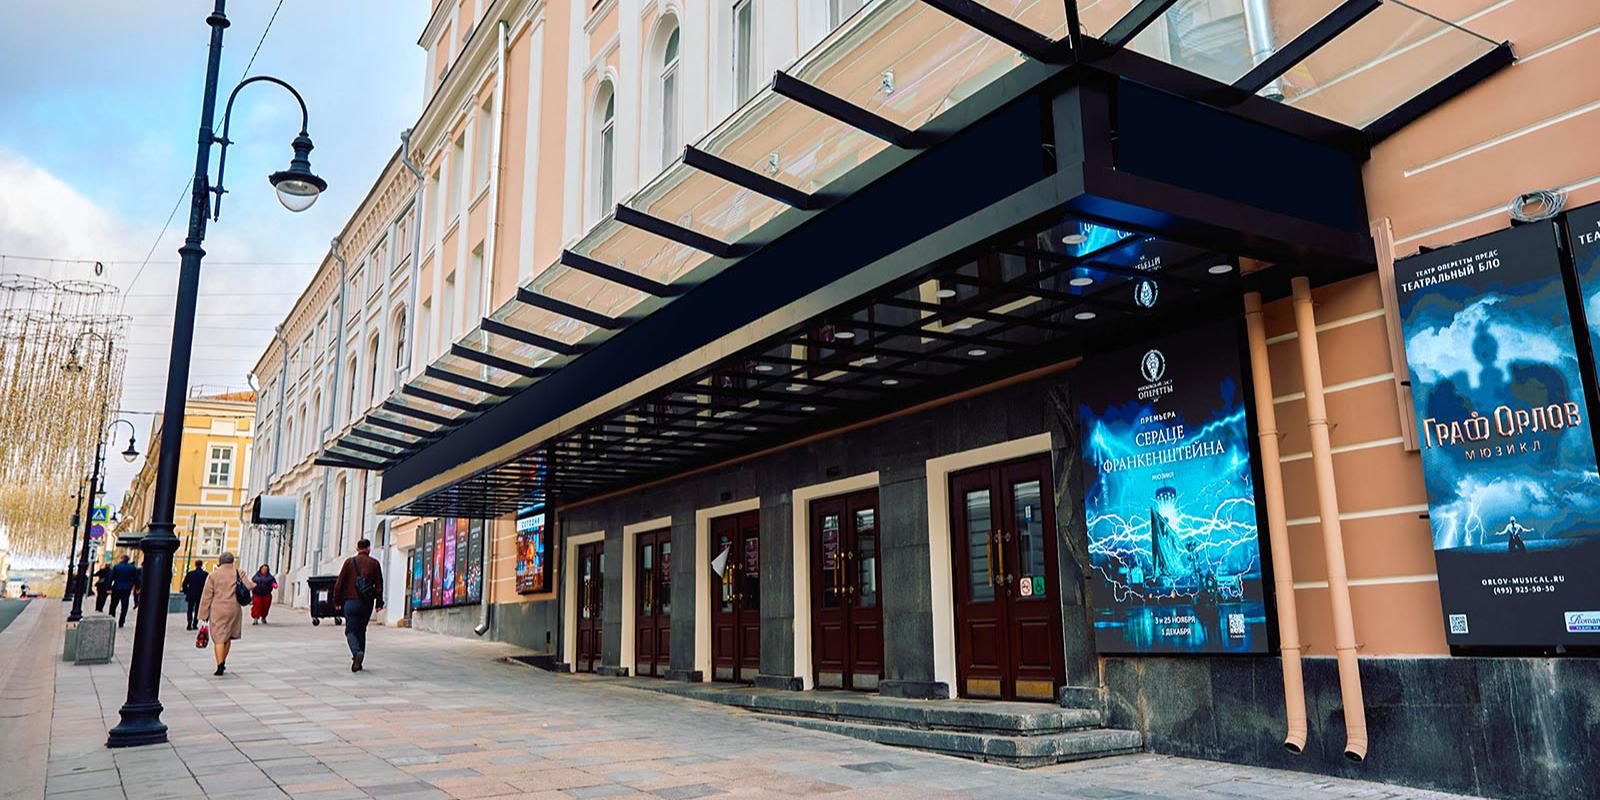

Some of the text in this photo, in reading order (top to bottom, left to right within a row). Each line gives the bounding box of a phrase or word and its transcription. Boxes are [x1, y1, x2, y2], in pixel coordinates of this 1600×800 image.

[1416, 249, 1498, 278] ТЕАТР ОПЕРЕТТЫ ПРЕДС
[1401, 258, 1500, 292] ТЕАТРАЛЬНЫЙ БЛО
[1138, 385, 1173, 400] ОПЕРЕТТЫ
[1140, 411, 1176, 424] ПРЕМЬЕРА
[1422, 402, 1582, 449] ГРАФ ОРЛОВ
[1136, 425, 1184, 447] СЕРДЦЕ
[1103, 440, 1225, 474] ФРАНКЕНШТЕЙНА
[1465, 440, 1541, 460] МЮЗИКЛ
[1482, 576, 1565, 586] ORLOV-MUSICAL.RU
[1172, 616, 1196, 624] НОЯБРЯ
[1165, 628, 1192, 636] ДЕКАБРЯ
